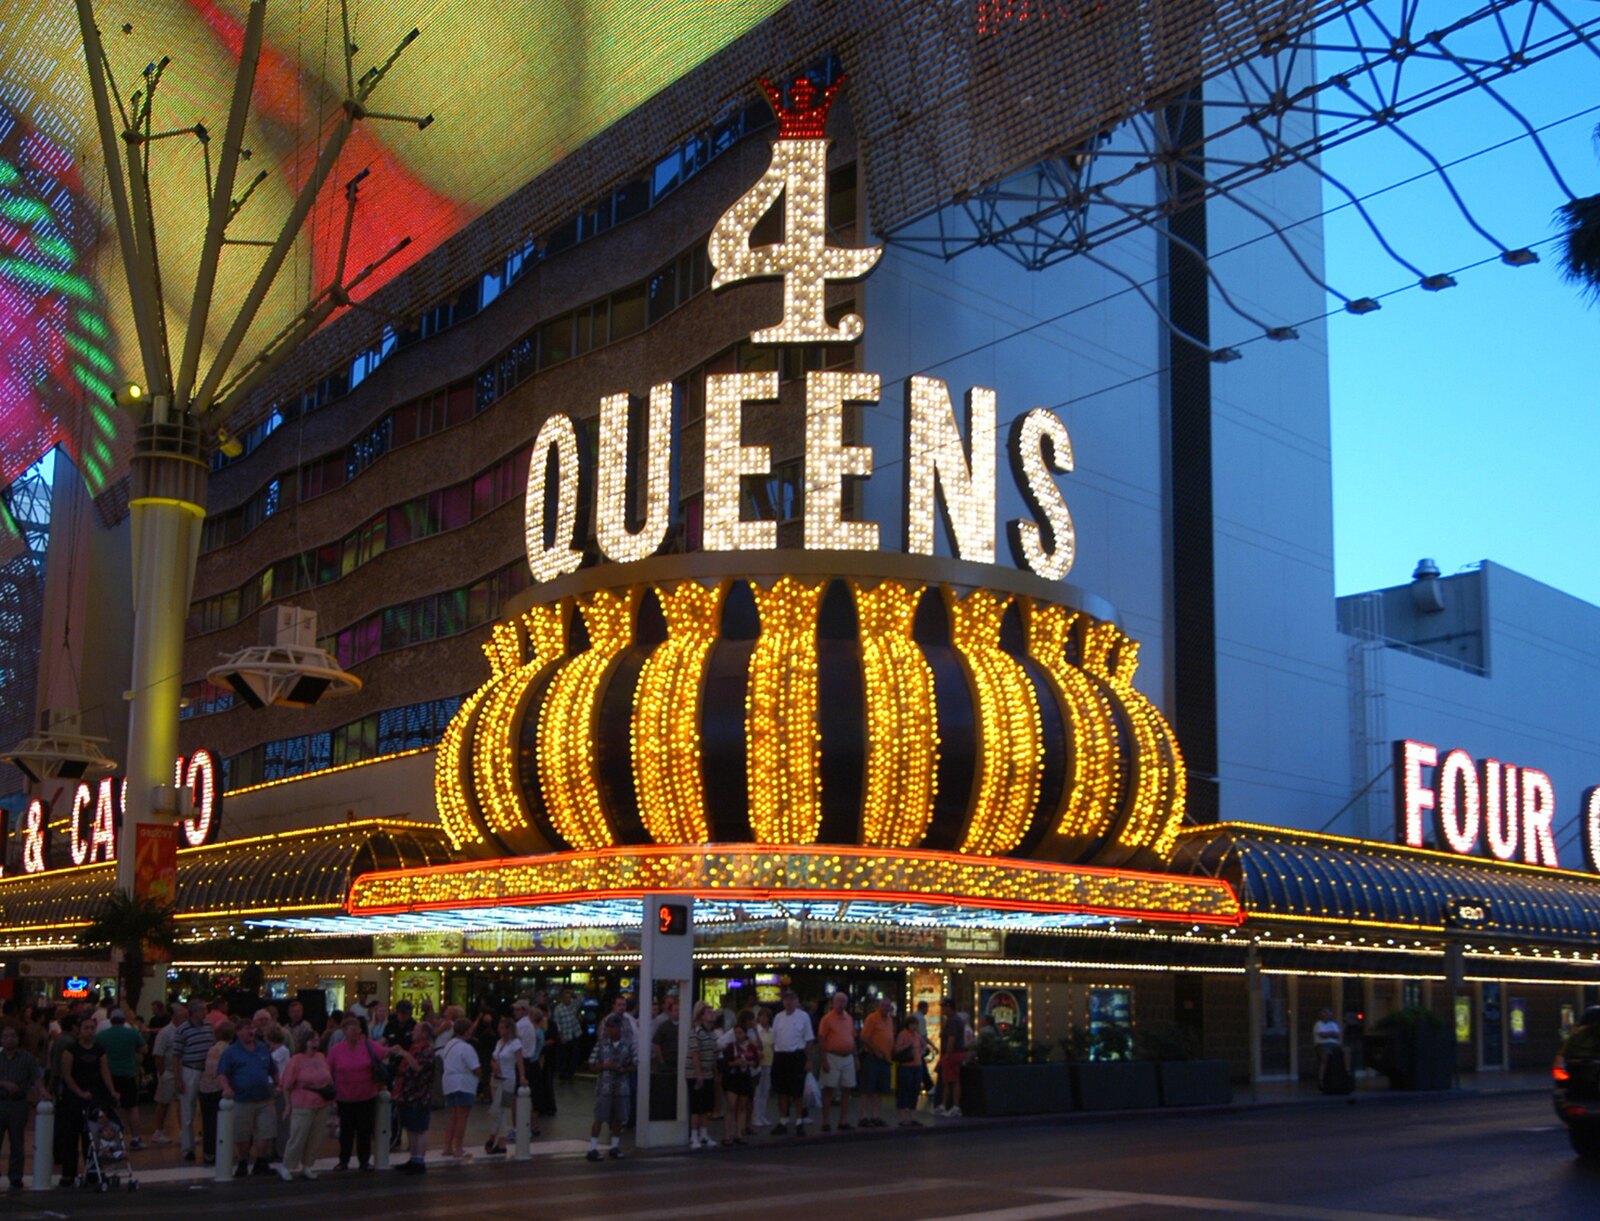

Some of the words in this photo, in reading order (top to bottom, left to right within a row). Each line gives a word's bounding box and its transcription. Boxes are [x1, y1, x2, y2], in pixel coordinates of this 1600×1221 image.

[707, 138, 885, 345] 4
[525, 371, 1076, 584] QUEENS
[23, 797, 46, 873] &
[71, 748, 215, 865] CAO
[1404, 739, 1559, 868] FOUR
